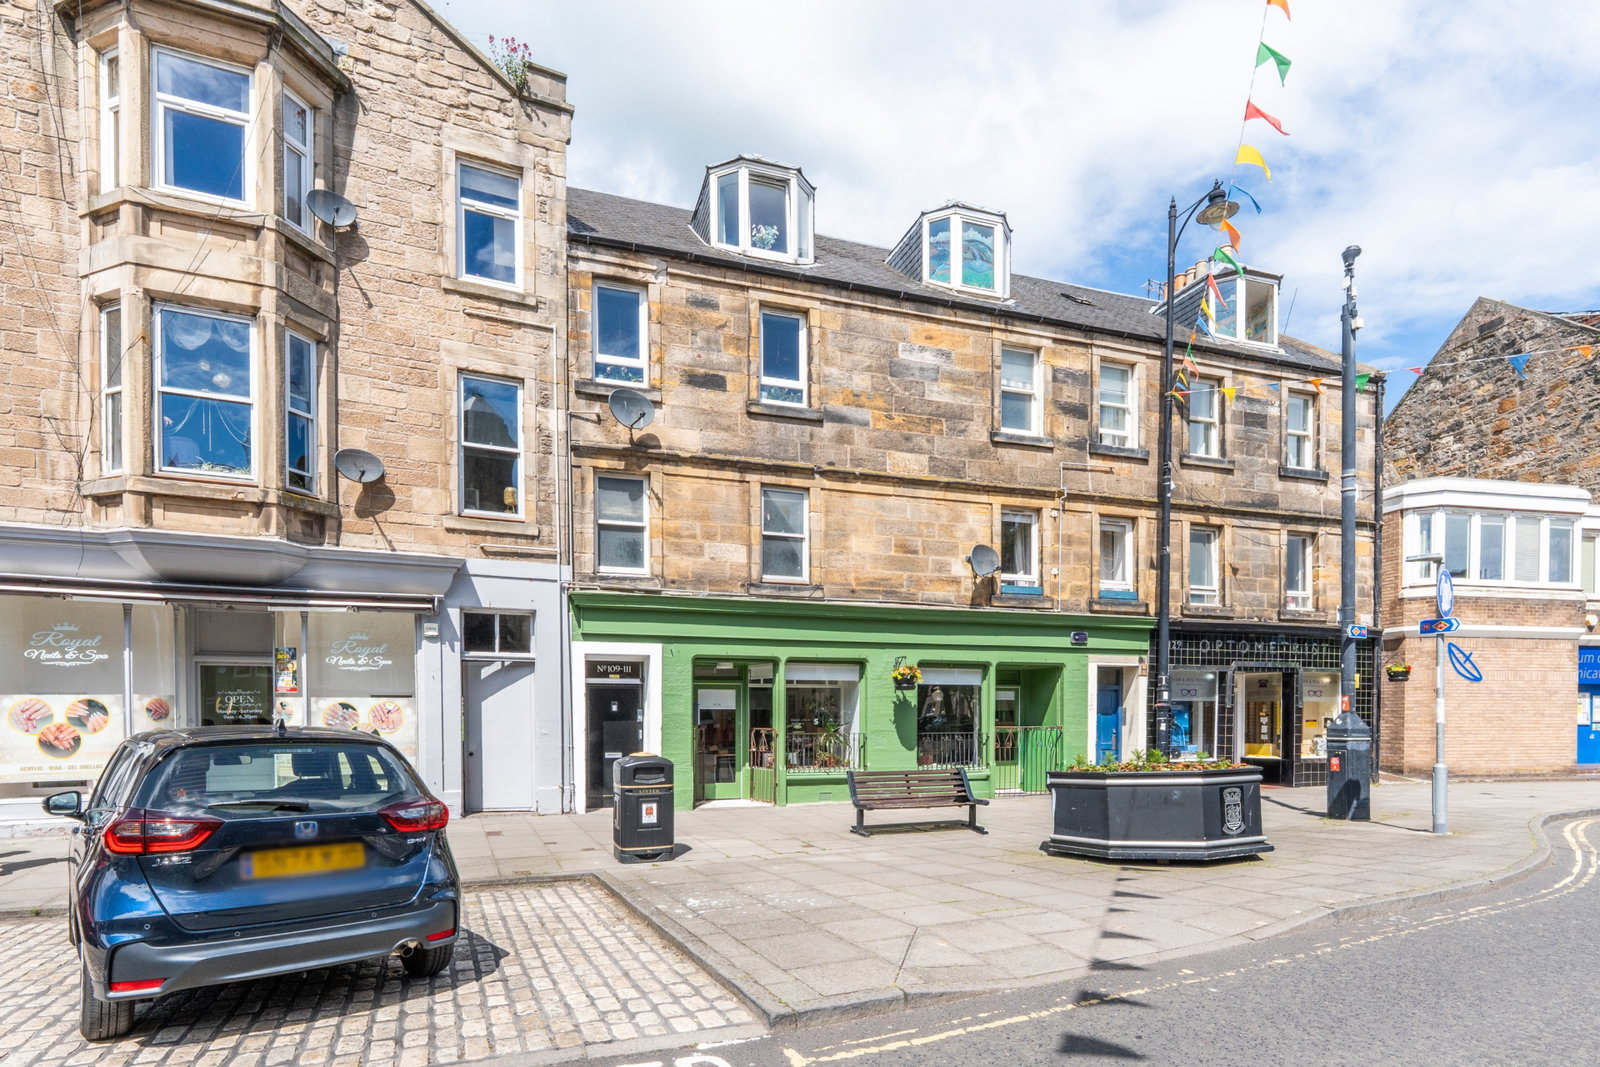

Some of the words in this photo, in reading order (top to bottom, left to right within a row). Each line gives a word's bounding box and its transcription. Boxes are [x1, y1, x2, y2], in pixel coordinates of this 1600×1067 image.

[30, 632, 102, 652] Royal
[1200, 639, 1330, 656] OPTOMETRIST
[24, 649, 62, 661] Nails
[65, 650, 79, 660] &
[80, 650, 109, 662] Spa
[330, 640, 388, 658] Royal
[325, 656, 356, 666] Nails
[358, 656, 369, 665] &
[369, 656, 392, 667] Spa
[225, 695, 254, 703] OPEN
[152, 856, 192, 867] JAZZ
